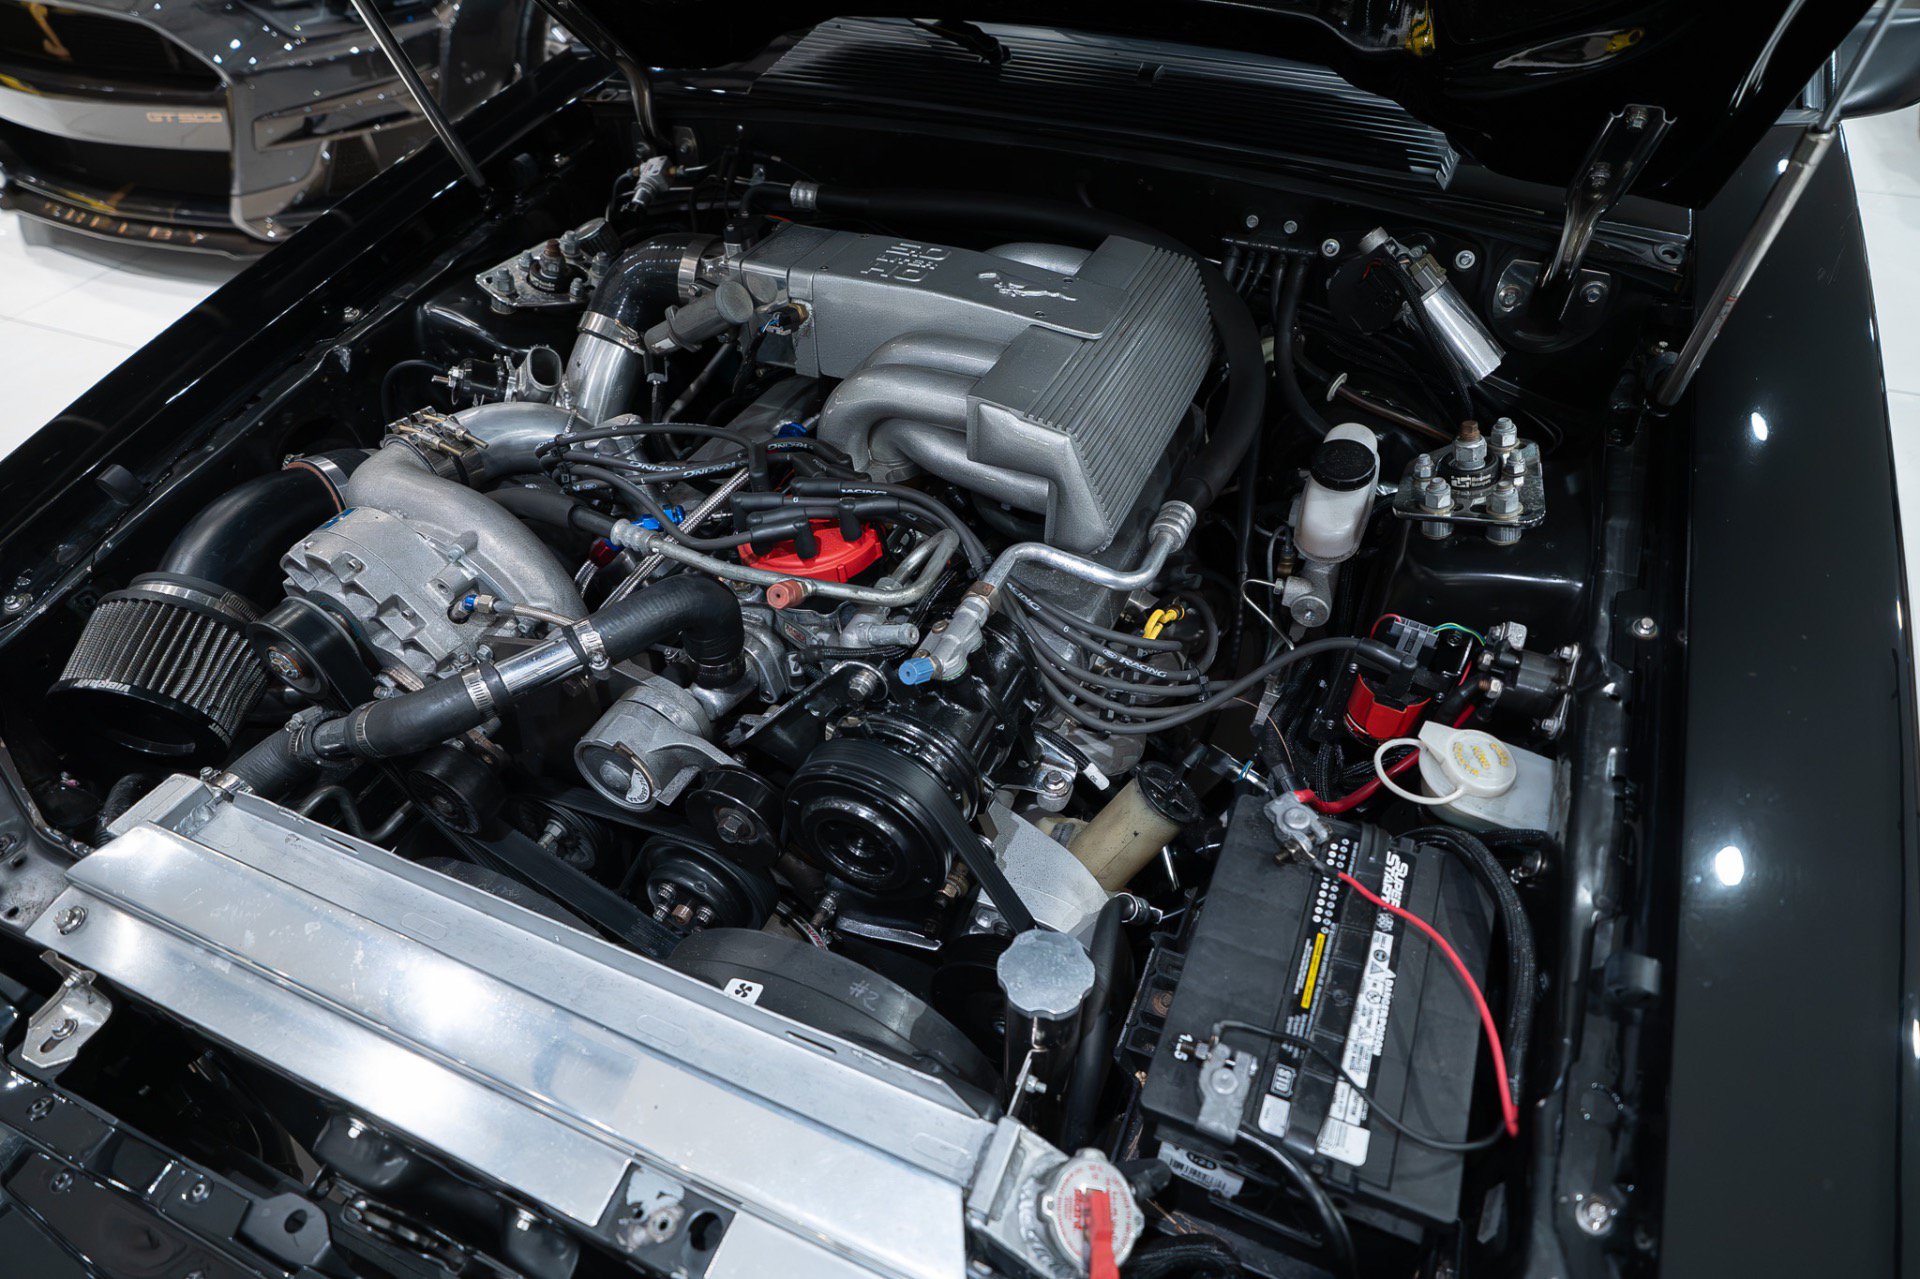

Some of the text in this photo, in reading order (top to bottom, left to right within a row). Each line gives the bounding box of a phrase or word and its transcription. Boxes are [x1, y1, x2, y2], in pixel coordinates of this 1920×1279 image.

[1118, 656, 1168, 678] RACING
[74, 679, 131, 692] VIBRANT
[1381, 851, 1401, 904] START
[850, 980, 879, 1011] #2
